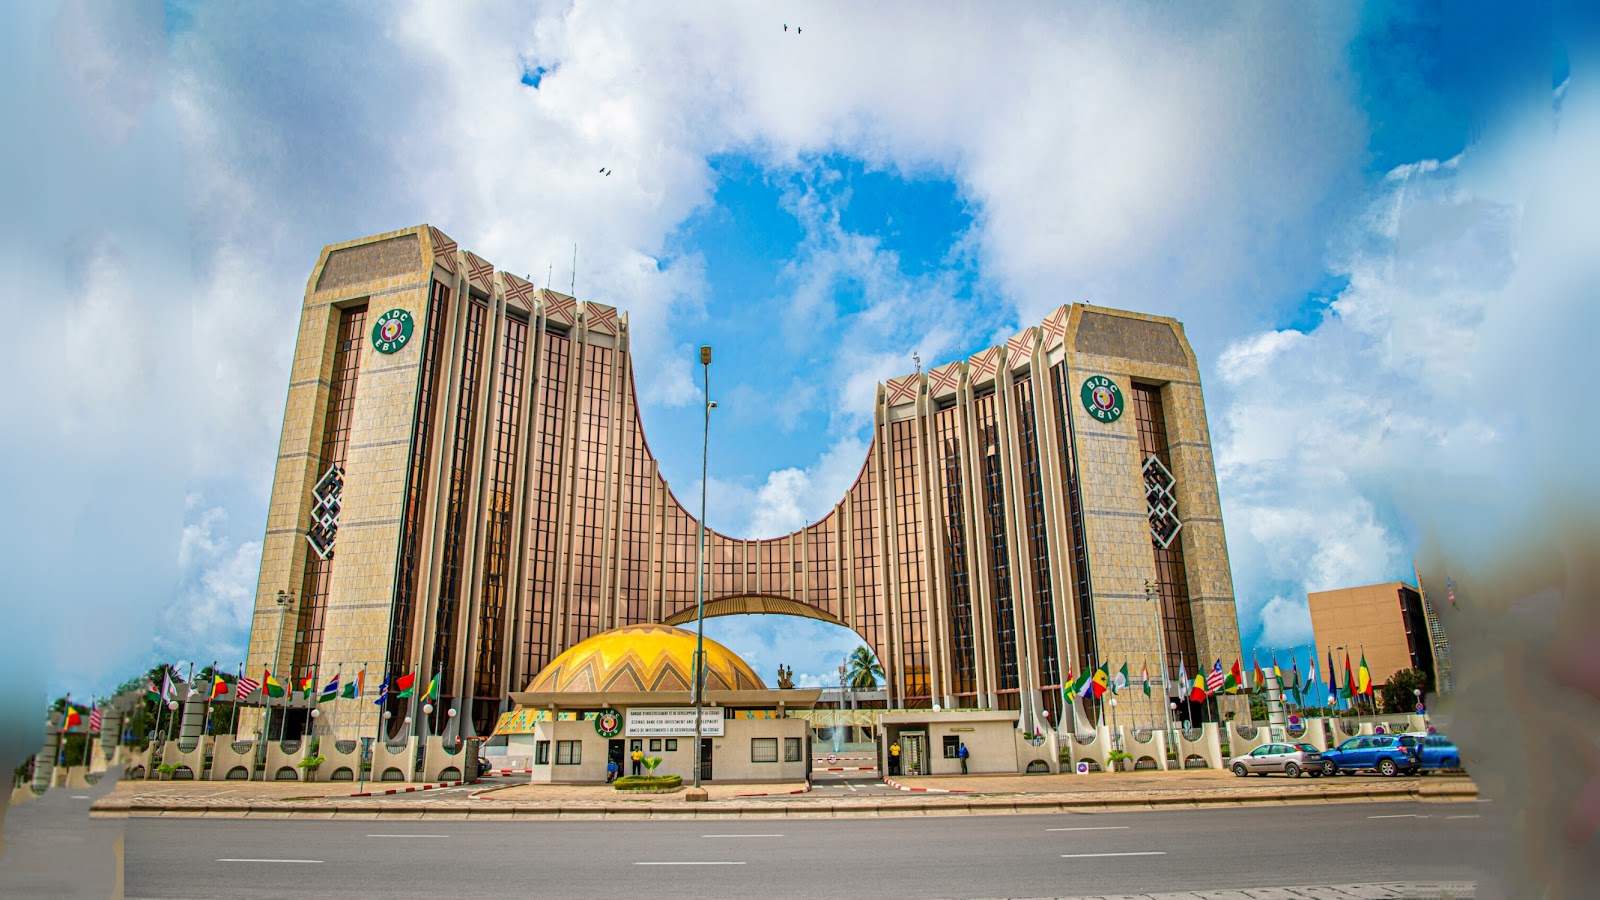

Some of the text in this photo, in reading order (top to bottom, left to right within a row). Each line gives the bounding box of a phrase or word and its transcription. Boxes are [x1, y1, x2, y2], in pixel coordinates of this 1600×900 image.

[378, 310, 408, 326] BIDC
[375, 334, 406, 351] EBID
[1087, 378, 1118, 393] BIDC
[1089, 404, 1120, 420] EBID
[599, 709, 620, 718] BIDC
[597, 728, 618, 736] EBID
